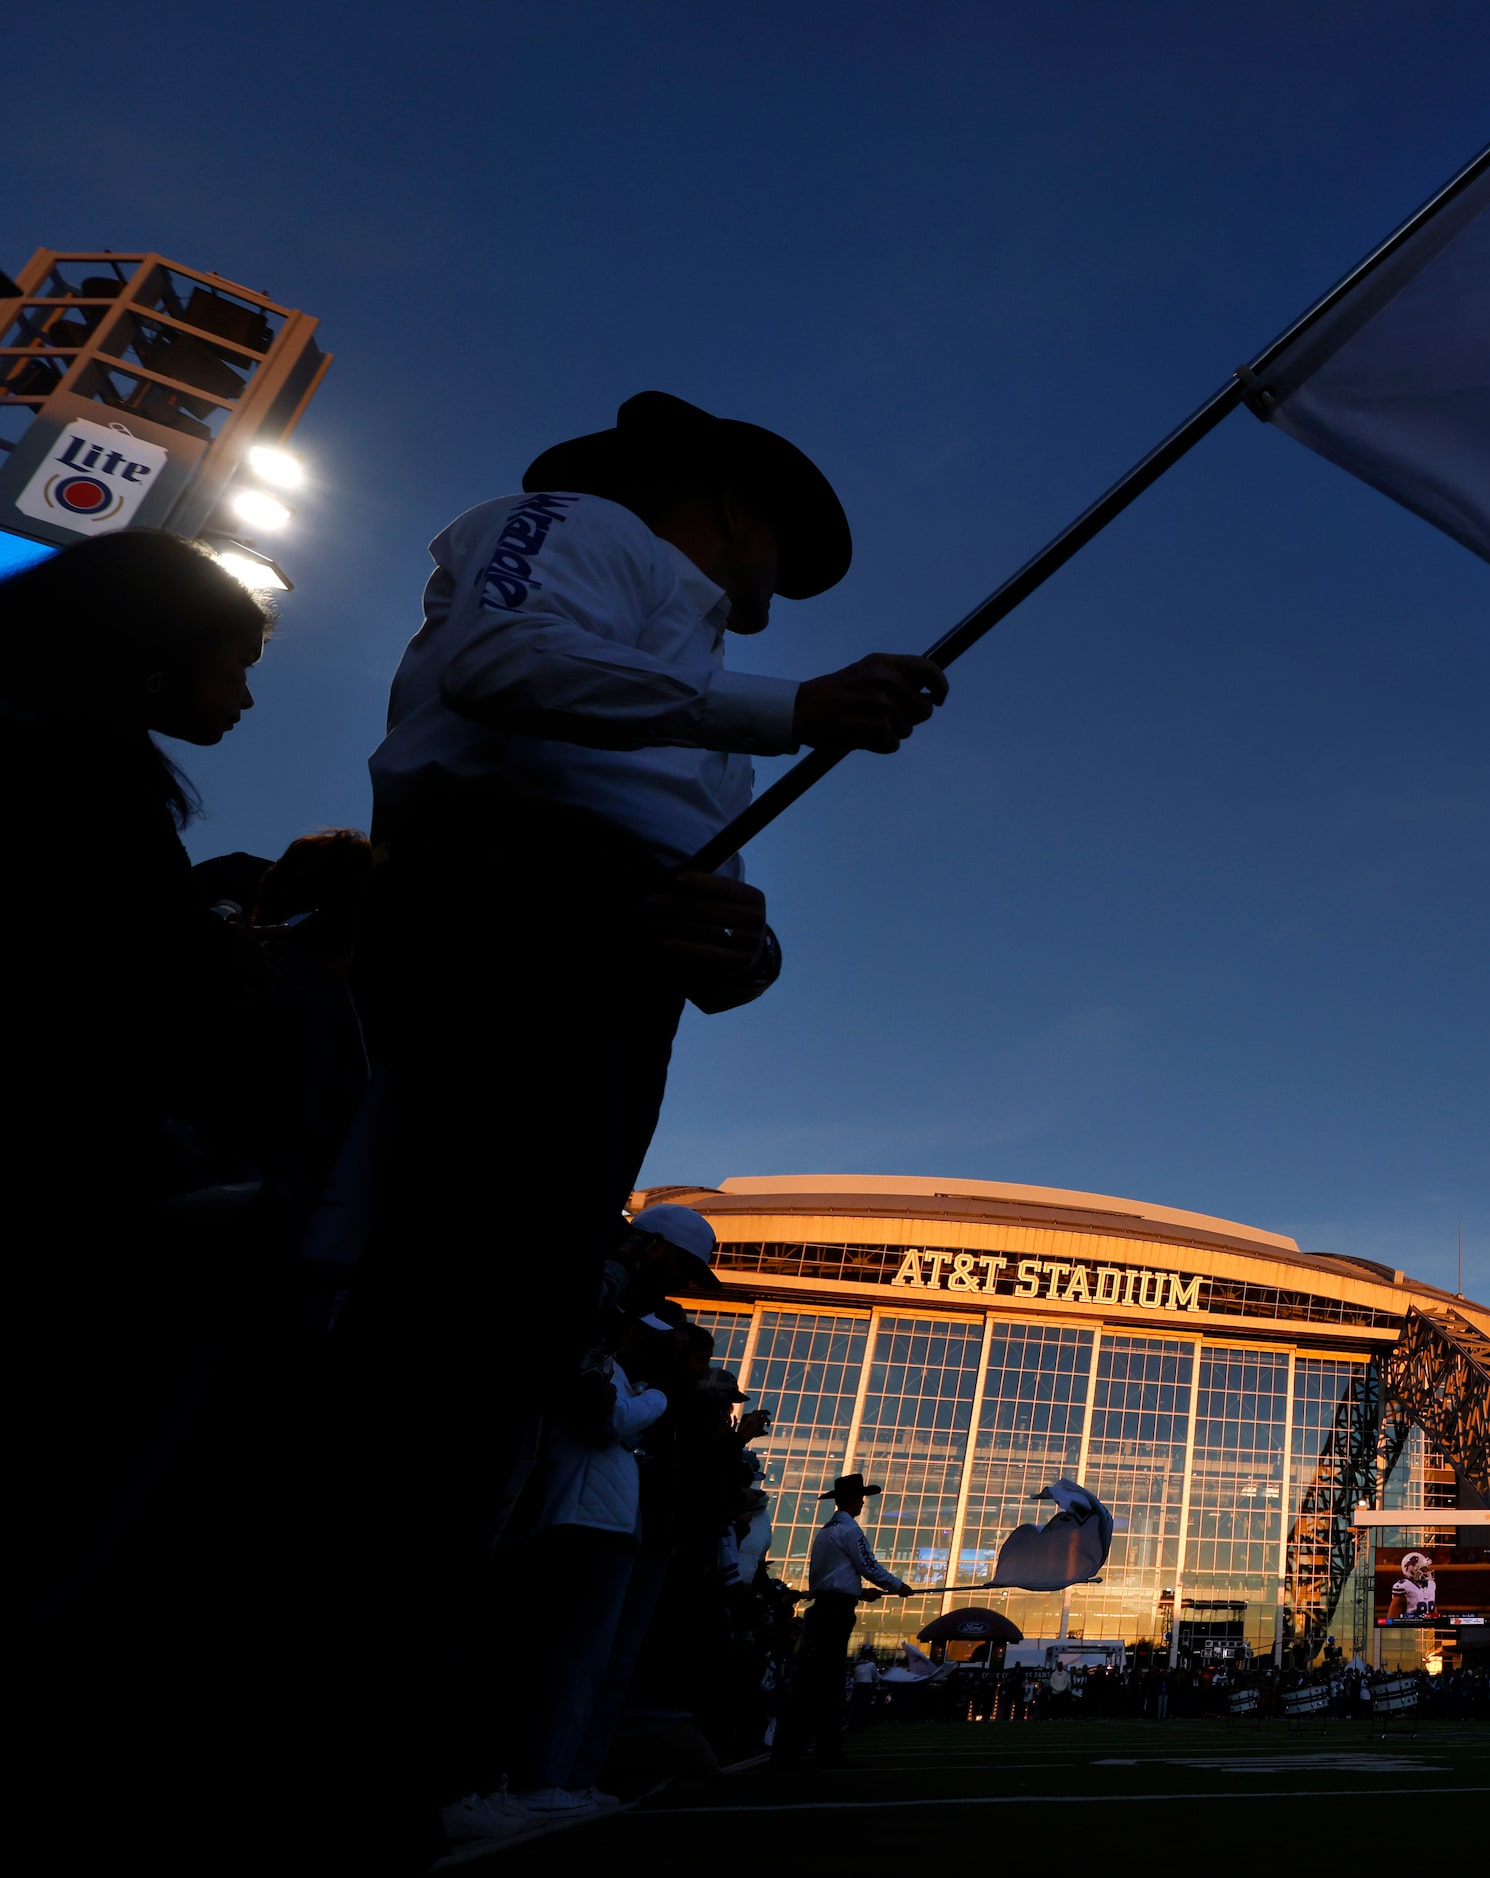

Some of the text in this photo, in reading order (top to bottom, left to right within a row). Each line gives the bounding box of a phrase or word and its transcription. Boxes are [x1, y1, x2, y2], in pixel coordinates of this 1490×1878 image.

[55, 434, 152, 483] Lite
[891, 1248, 1203, 1312] AT&T STADIUM
